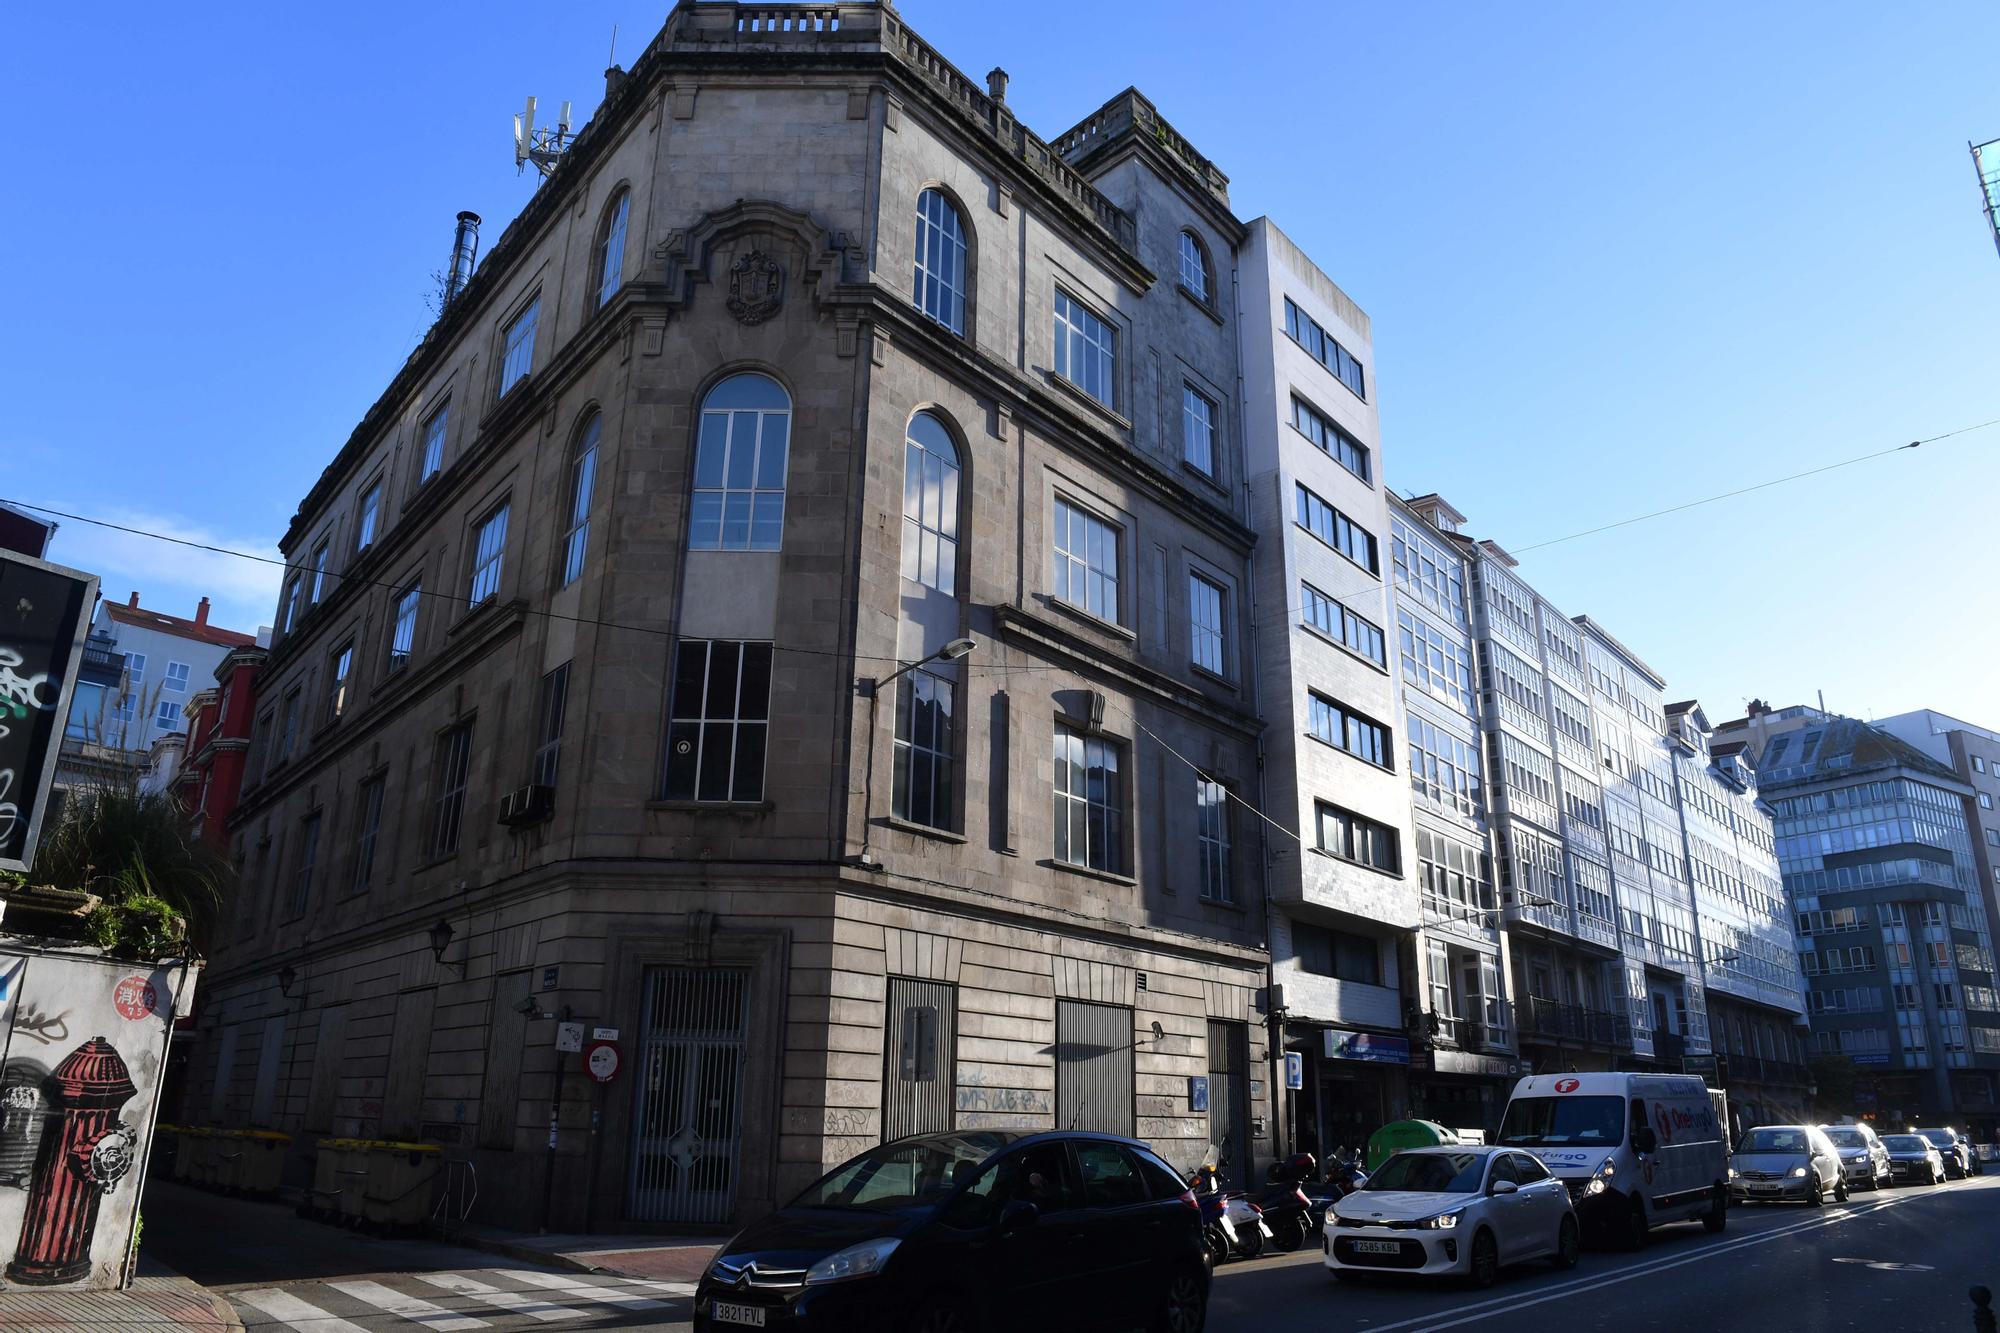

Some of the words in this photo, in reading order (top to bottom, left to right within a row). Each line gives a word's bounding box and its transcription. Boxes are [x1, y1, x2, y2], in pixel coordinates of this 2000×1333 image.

[1288, 1057, 1300, 1083] P
[719, 1304, 741, 1321] 3821
[744, 1307, 762, 1324] FVL
